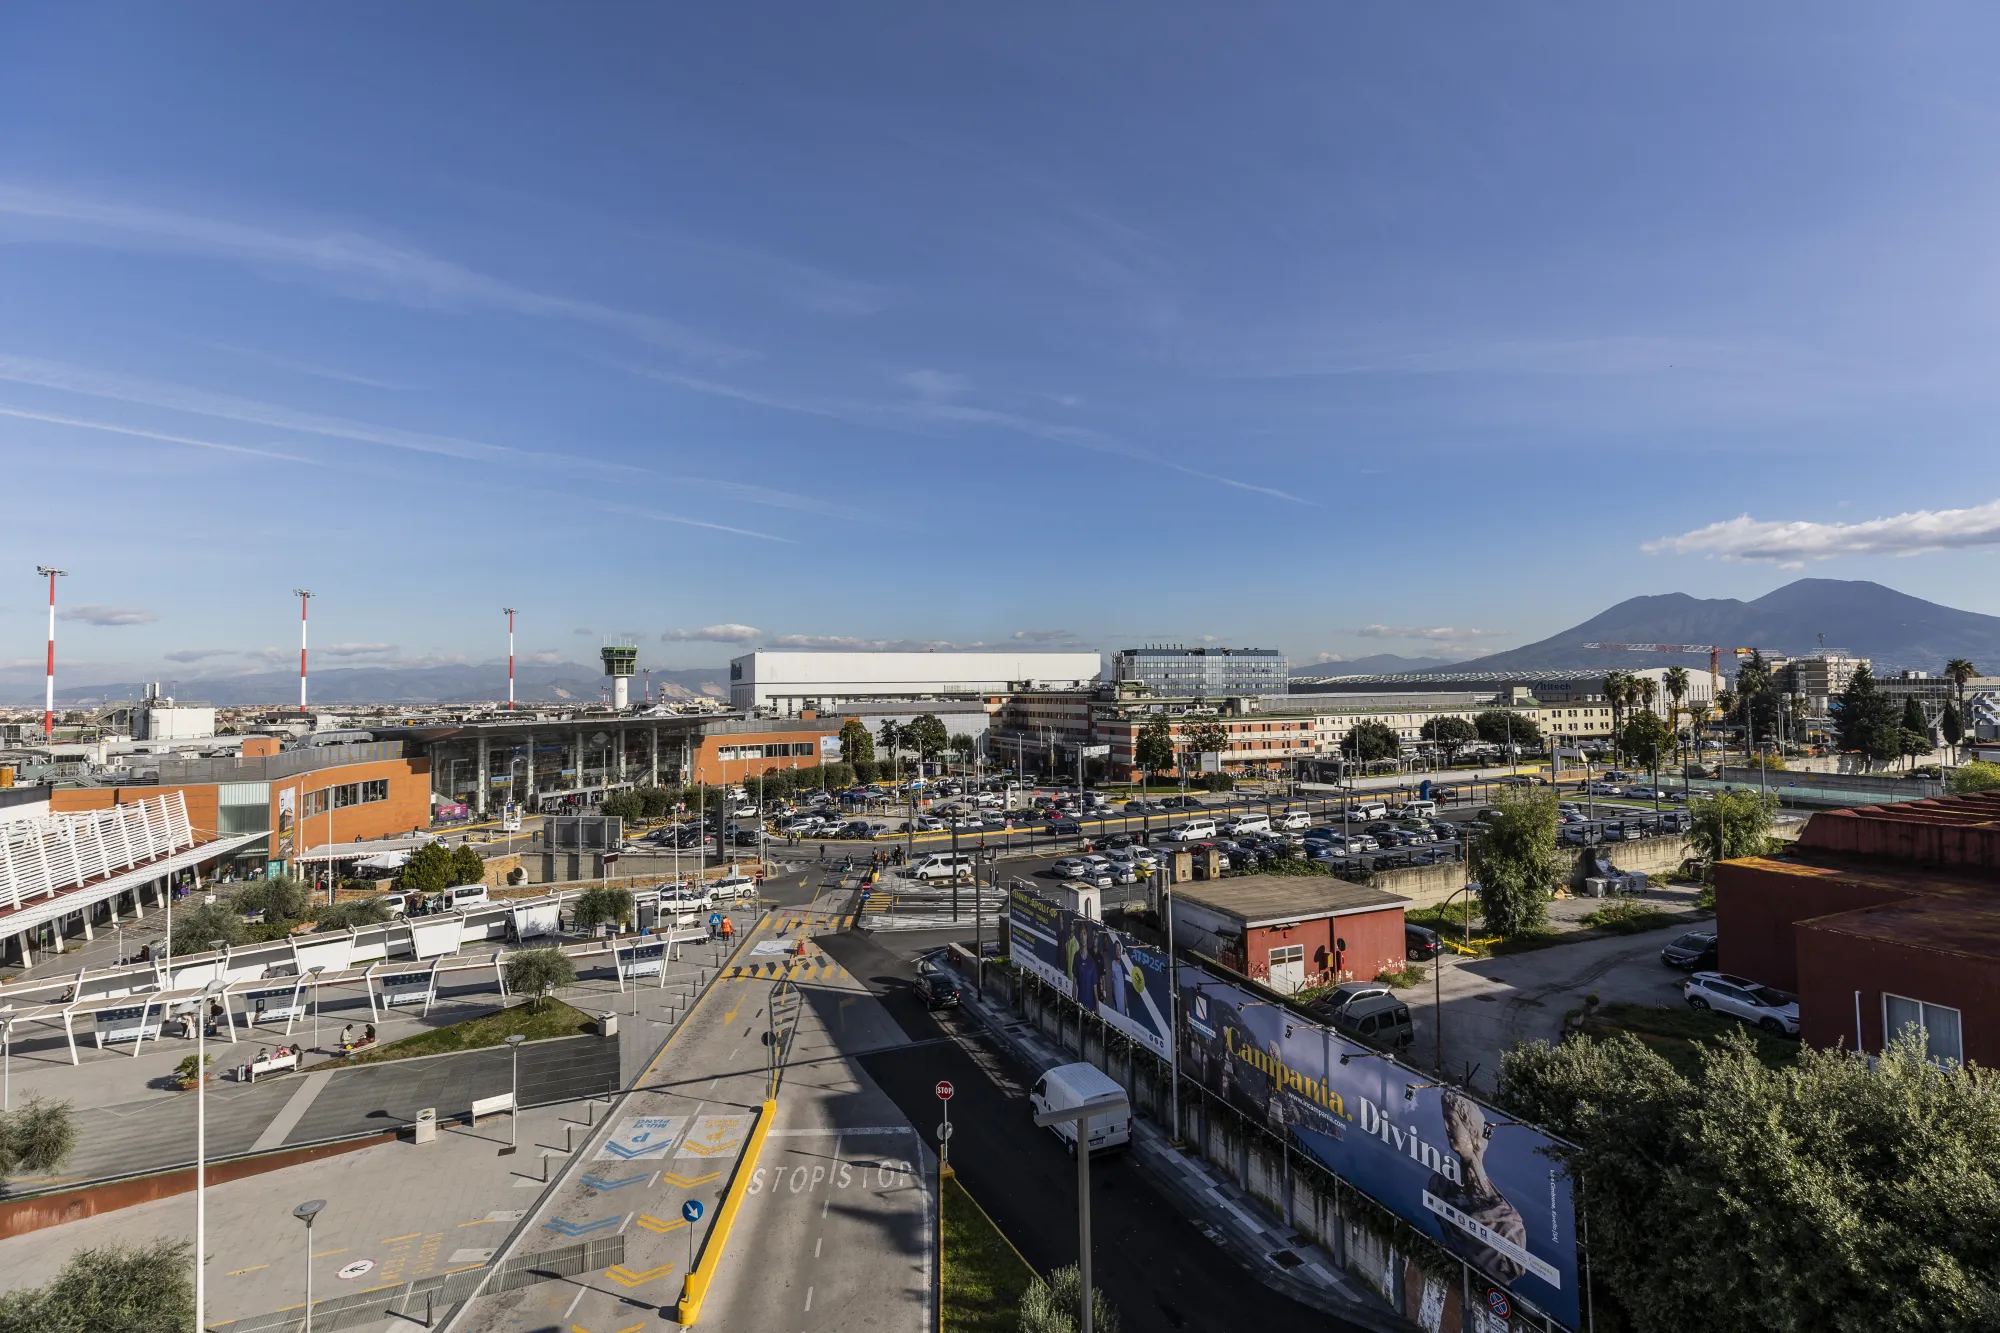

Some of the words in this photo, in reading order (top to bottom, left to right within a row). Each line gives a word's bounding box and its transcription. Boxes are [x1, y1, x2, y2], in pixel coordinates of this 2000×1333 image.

[937, 1086, 952, 1095] STOP
[1226, 1026, 1353, 1122] Campania.
[1288, 1092, 1347, 1131] www.incampania.com
[1359, 1095, 1465, 1187] Divina
[747, 1165, 825, 1195] STOP
[837, 1160, 912, 1189] STOP
